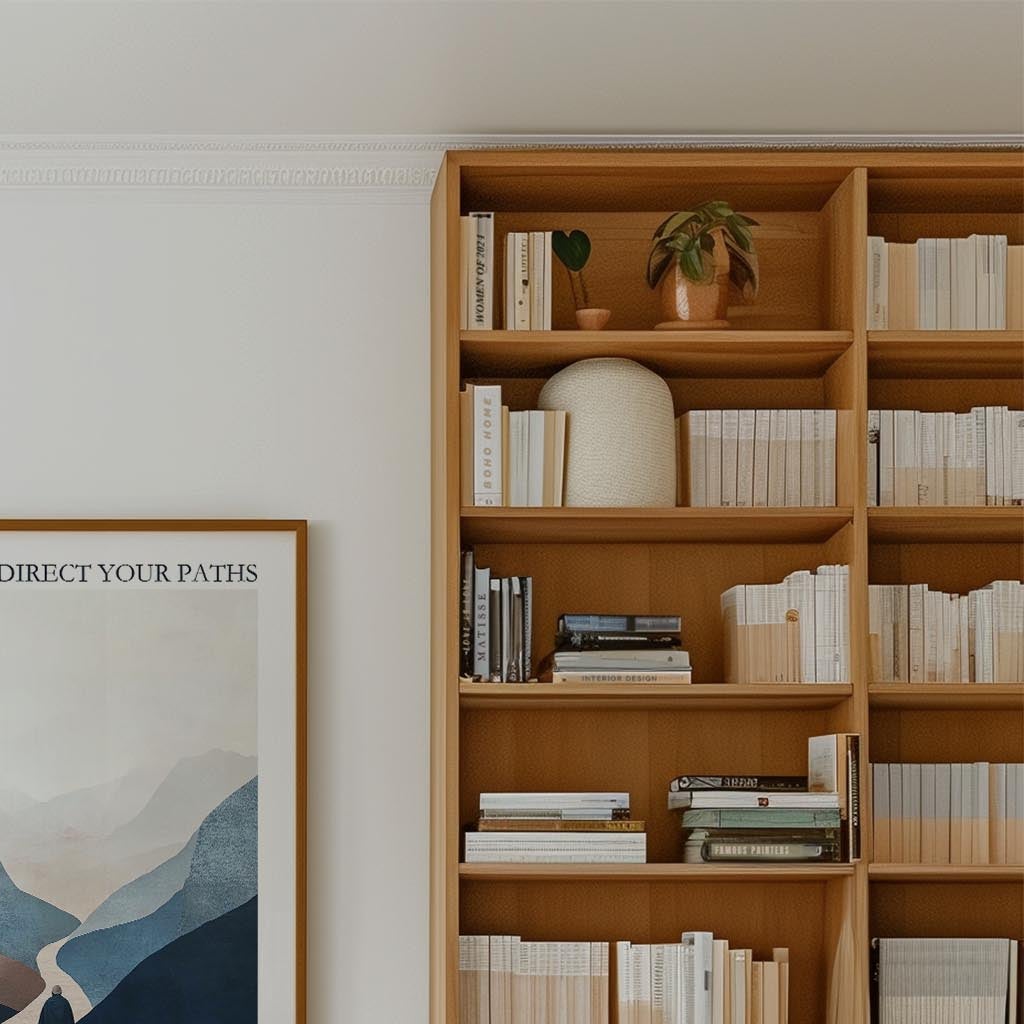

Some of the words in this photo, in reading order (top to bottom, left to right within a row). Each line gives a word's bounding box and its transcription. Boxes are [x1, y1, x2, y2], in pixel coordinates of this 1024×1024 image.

[476, 260, 485, 276] OF
[475, 280, 485, 323] WOMEN
[483, 397, 492, 440] HOME
[483, 447, 492, 489] BOHO
[98, 563, 171, 583] YOUR
[177, 563, 258, 583] PATHS
[477, 593, 487, 661] MATISSE
[714, 845, 747, 856] FAMOUS
